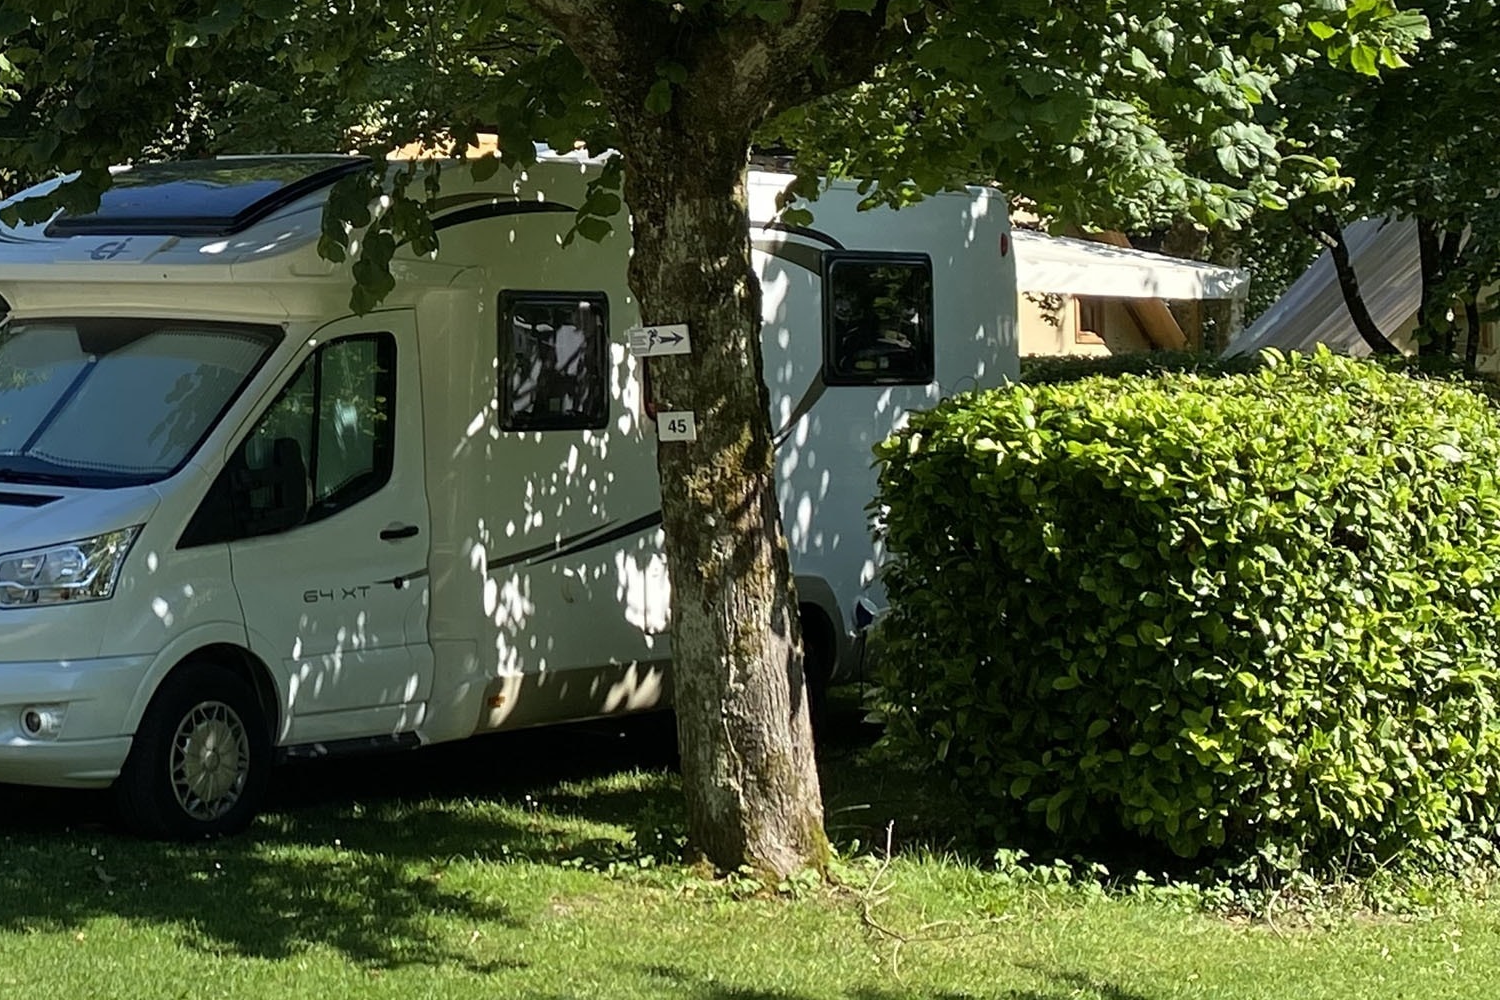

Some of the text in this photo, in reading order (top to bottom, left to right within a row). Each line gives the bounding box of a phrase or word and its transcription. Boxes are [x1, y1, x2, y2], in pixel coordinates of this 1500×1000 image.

[668, 419, 687, 433] 45
[303, 585, 371, 603] 64 XT
